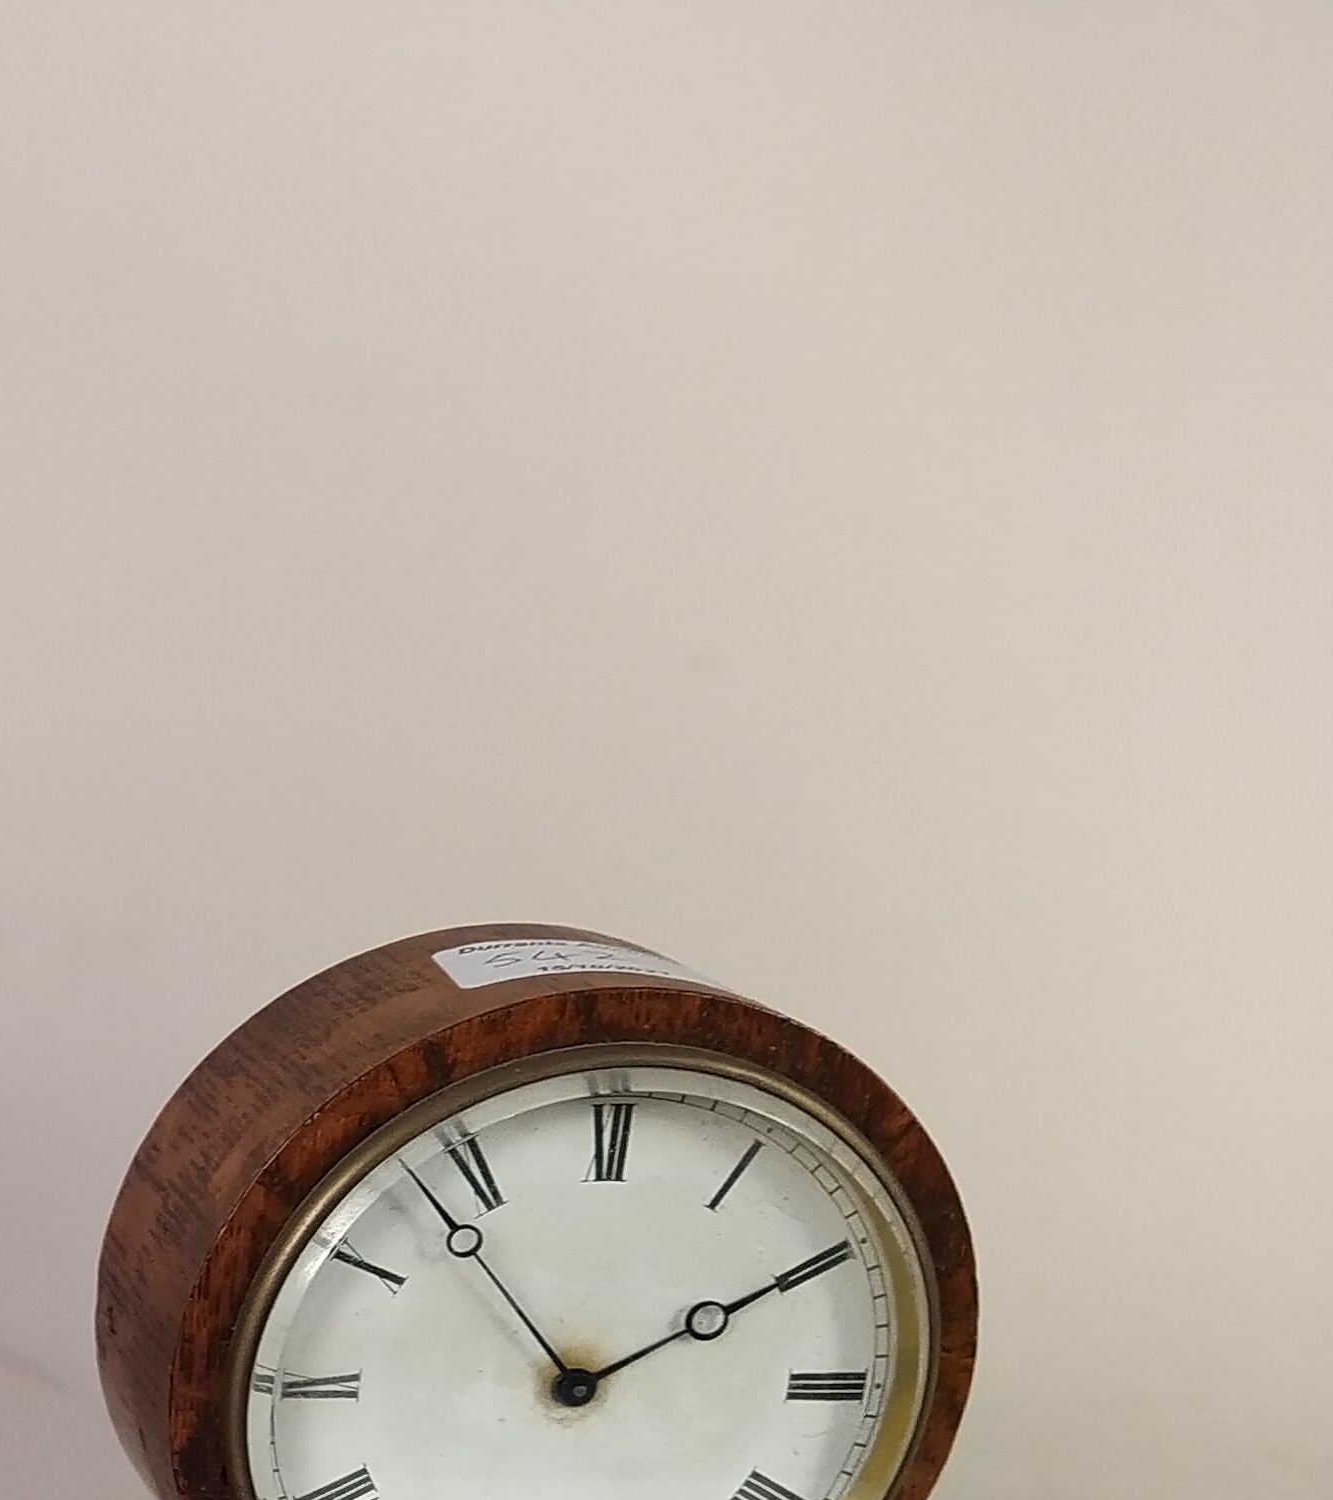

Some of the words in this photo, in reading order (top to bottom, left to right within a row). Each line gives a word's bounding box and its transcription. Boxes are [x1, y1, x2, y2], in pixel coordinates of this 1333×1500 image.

[443, 1132, 509, 1219] XI
[581, 1103, 637, 1182] XII
[703, 1140, 766, 1211] I
[771, 1238, 856, 1293] II
[785, 1371, 869, 1402] III
